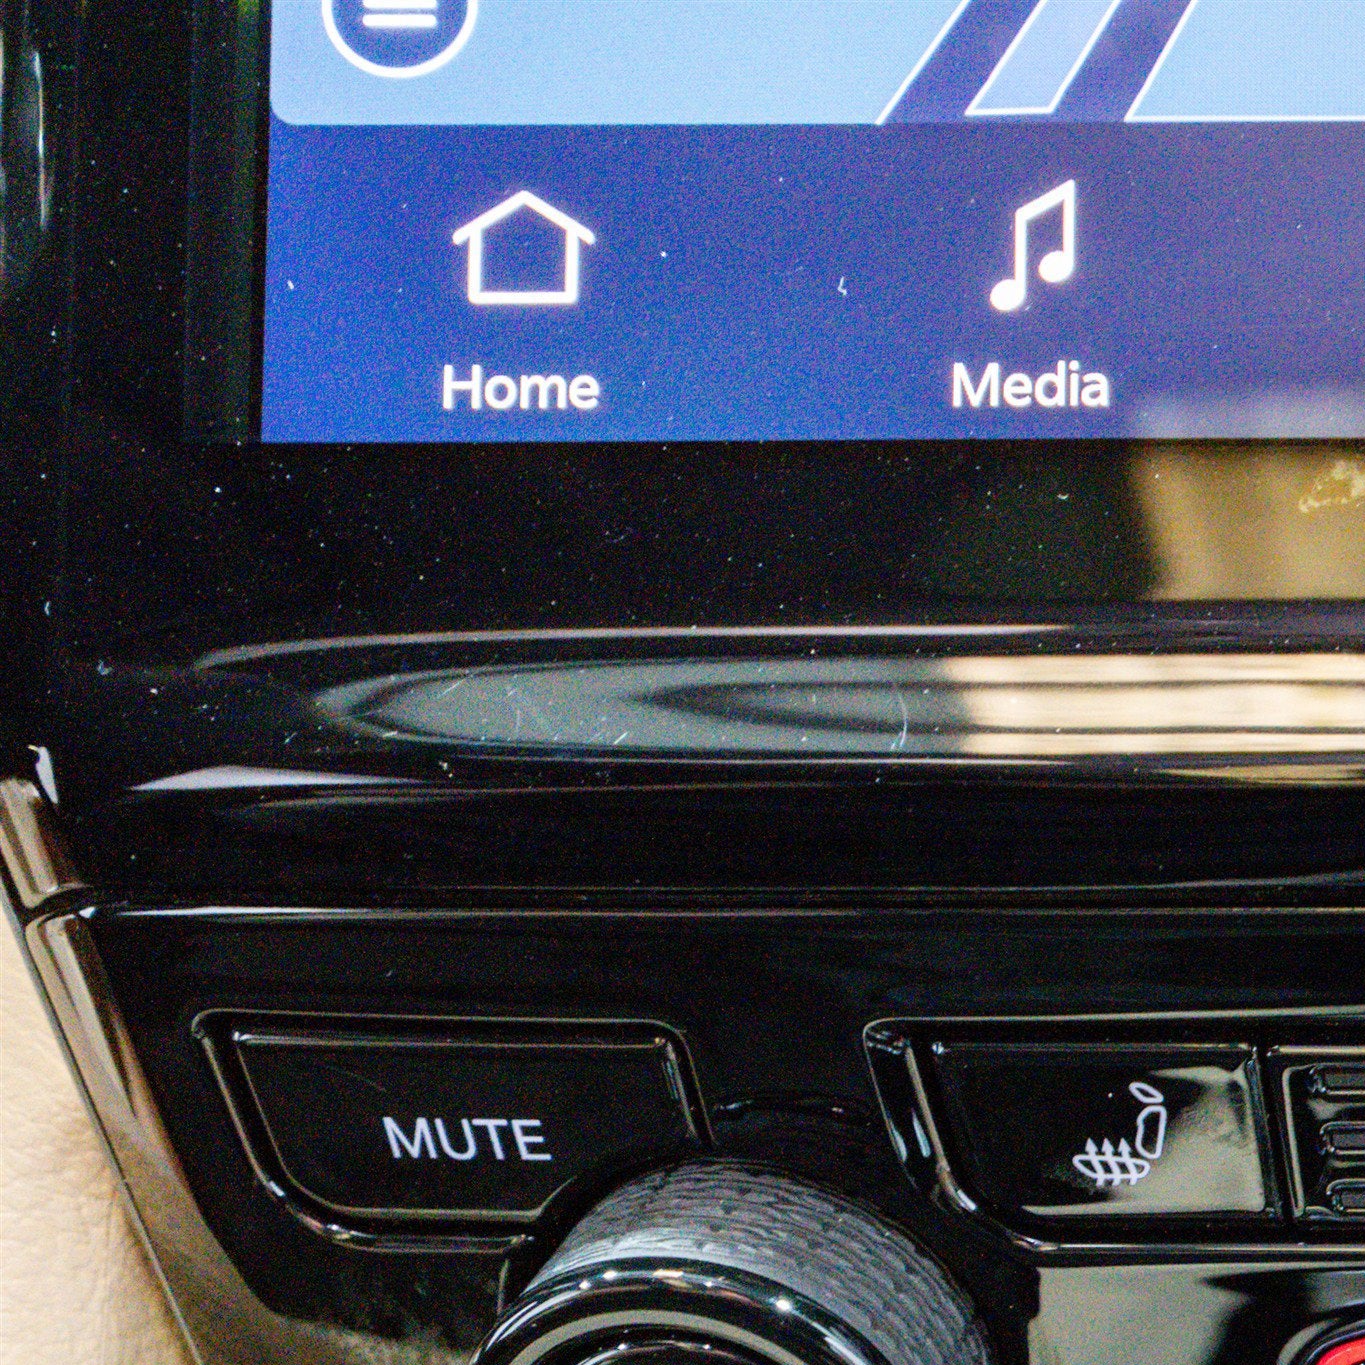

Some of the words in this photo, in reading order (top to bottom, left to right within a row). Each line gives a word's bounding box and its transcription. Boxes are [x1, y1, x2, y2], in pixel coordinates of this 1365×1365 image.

[442, 363, 601, 411] Home
[952, 359, 1110, 409] Media
[383, 1116, 552, 1161] MUTE
